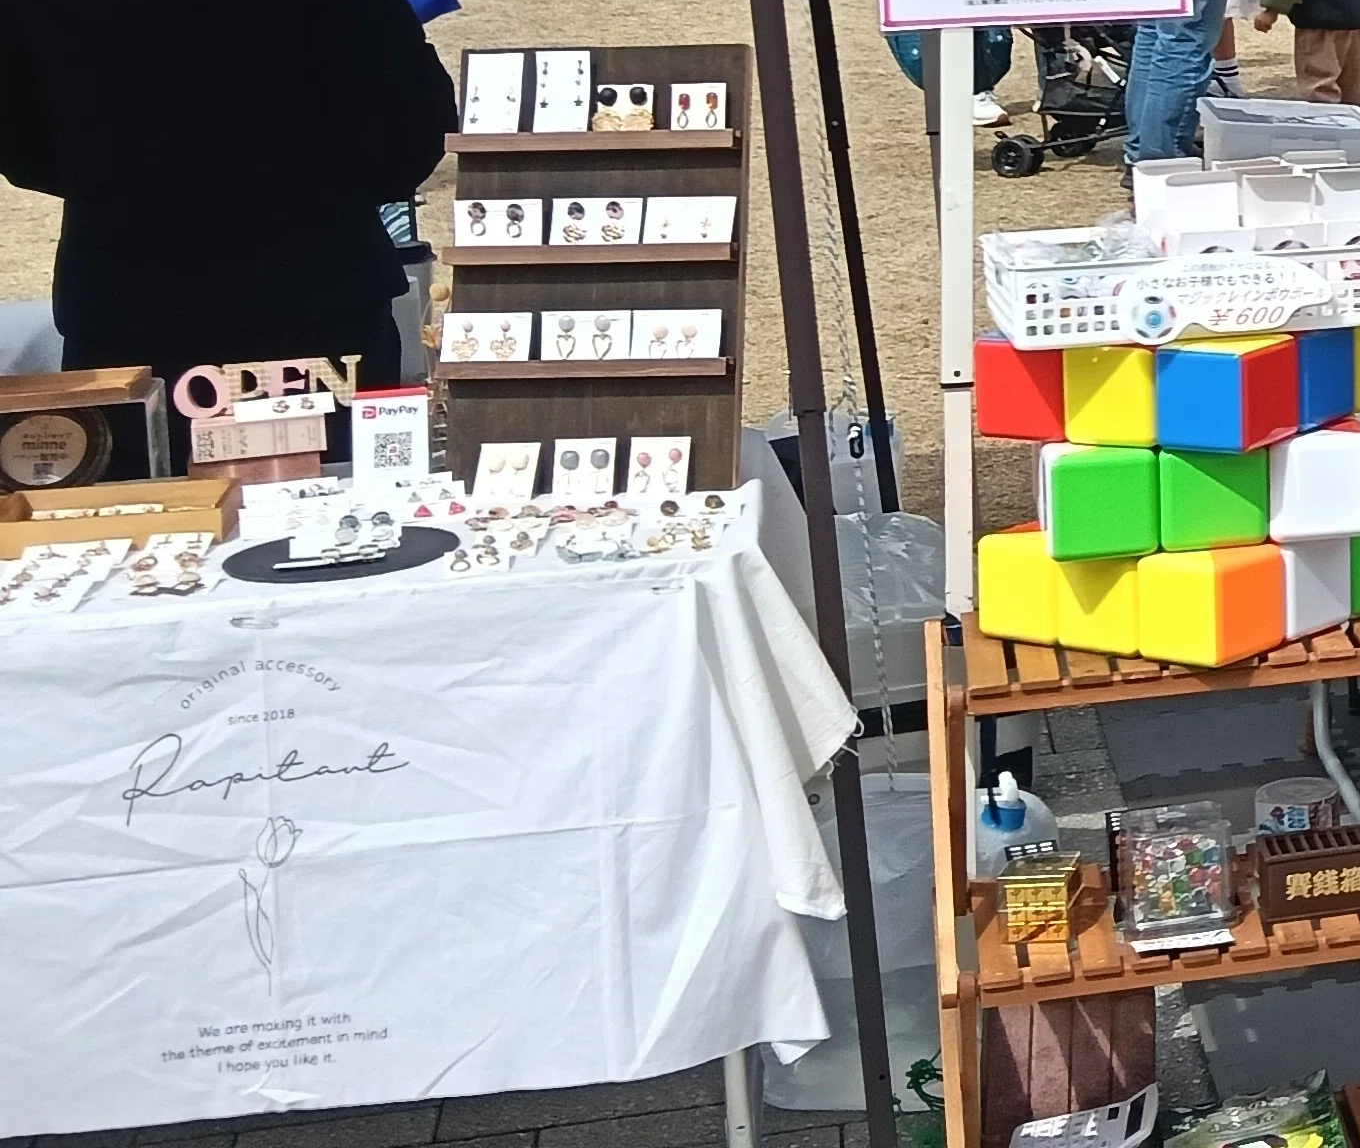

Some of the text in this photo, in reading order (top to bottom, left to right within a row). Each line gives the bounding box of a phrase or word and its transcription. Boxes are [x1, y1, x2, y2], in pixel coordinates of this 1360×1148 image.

[173, 355, 362, 419] OPEN
[378, 405, 419, 416] PayPay
[180, 658, 342, 710] original accessory
[228, 708, 296, 726] since 2018
[198, 1013, 351, 1038] We are making it with
[161, 1050, 185, 1062] the
[189, 1043, 235, 1058] theme
[239, 1039, 254, 1052] of
[257, 1033, 332, 1050] excitement
[337, 1031, 349, 1042] in
[226, 1060, 260, 1074] hope
[265, 1058, 288, 1073] you
[293, 1055, 319, 1066] like
